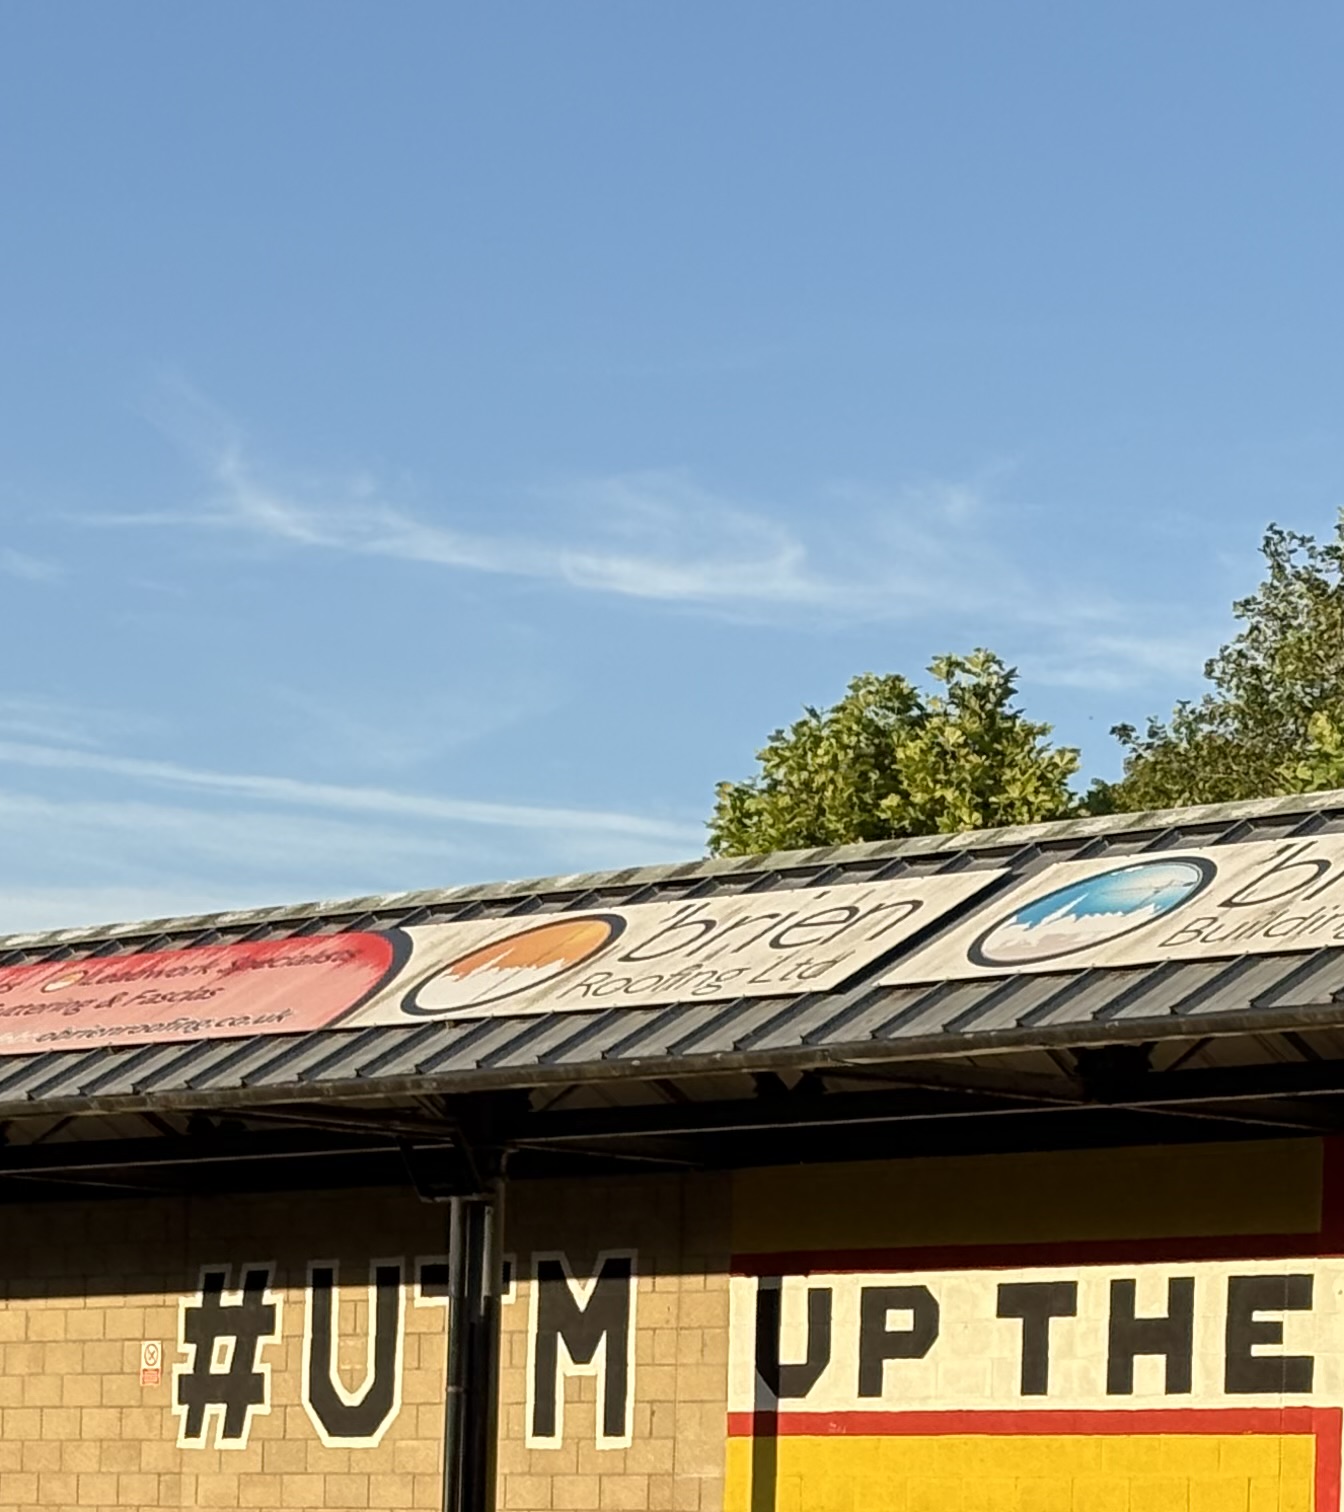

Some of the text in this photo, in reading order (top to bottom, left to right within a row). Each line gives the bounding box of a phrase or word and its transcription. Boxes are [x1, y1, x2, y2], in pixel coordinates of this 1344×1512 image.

[557, 950, 855, 998] Roofing Ltd
[756, 1284, 940, 1399] UP
[996, 1273, 1314, 1396] THE
